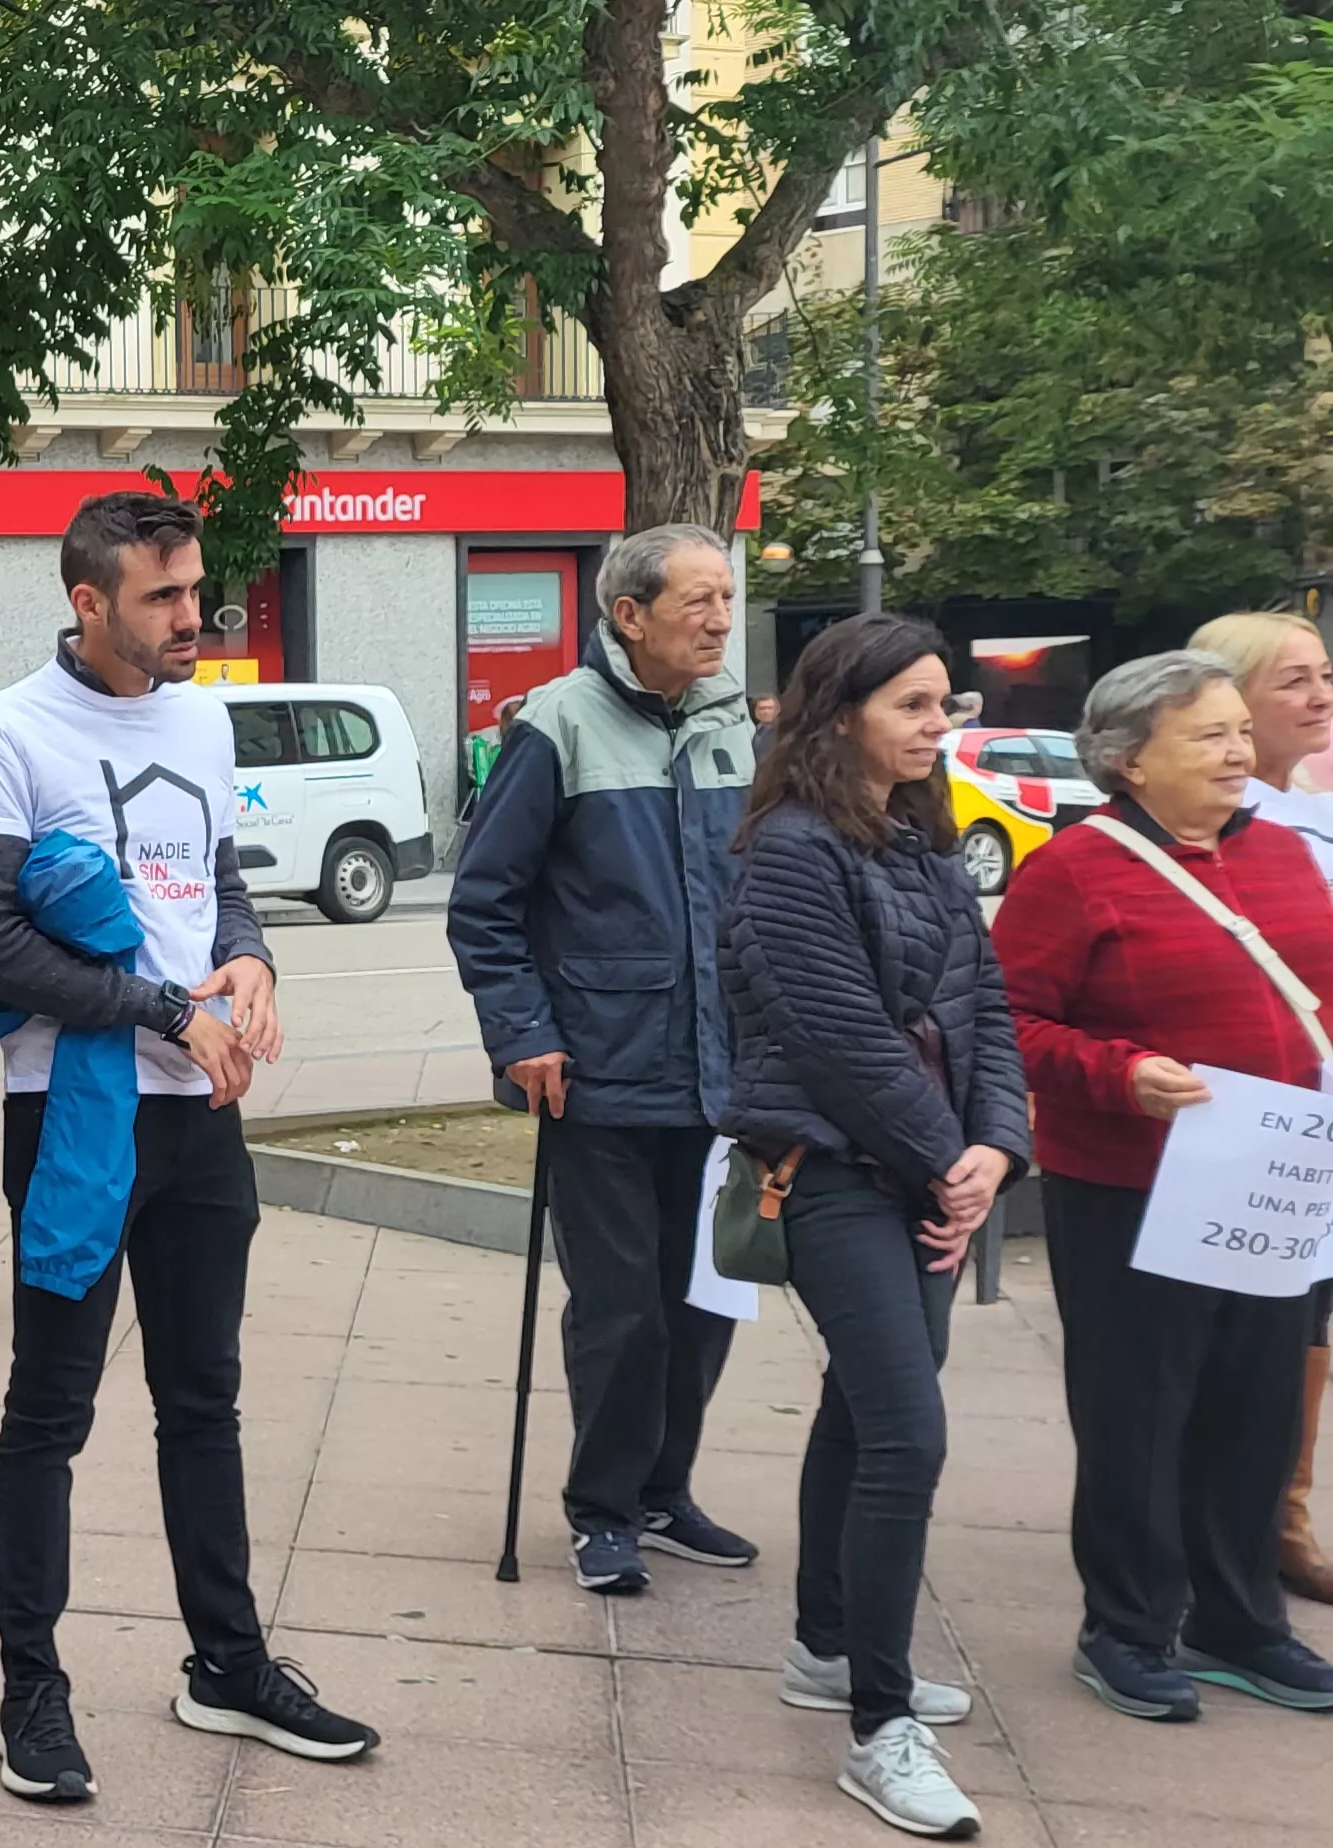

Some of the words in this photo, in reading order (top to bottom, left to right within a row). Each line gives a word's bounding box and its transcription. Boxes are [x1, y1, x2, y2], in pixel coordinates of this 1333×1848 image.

[274, 487, 427, 521] antander
[138, 842, 191, 860] NADIE
[139, 863, 168, 881] SIN
[1260, 1111, 1293, 1132] EN
[1247, 1192, 1296, 1215] UNA
[1200, 1221, 1317, 1260] 280-30
